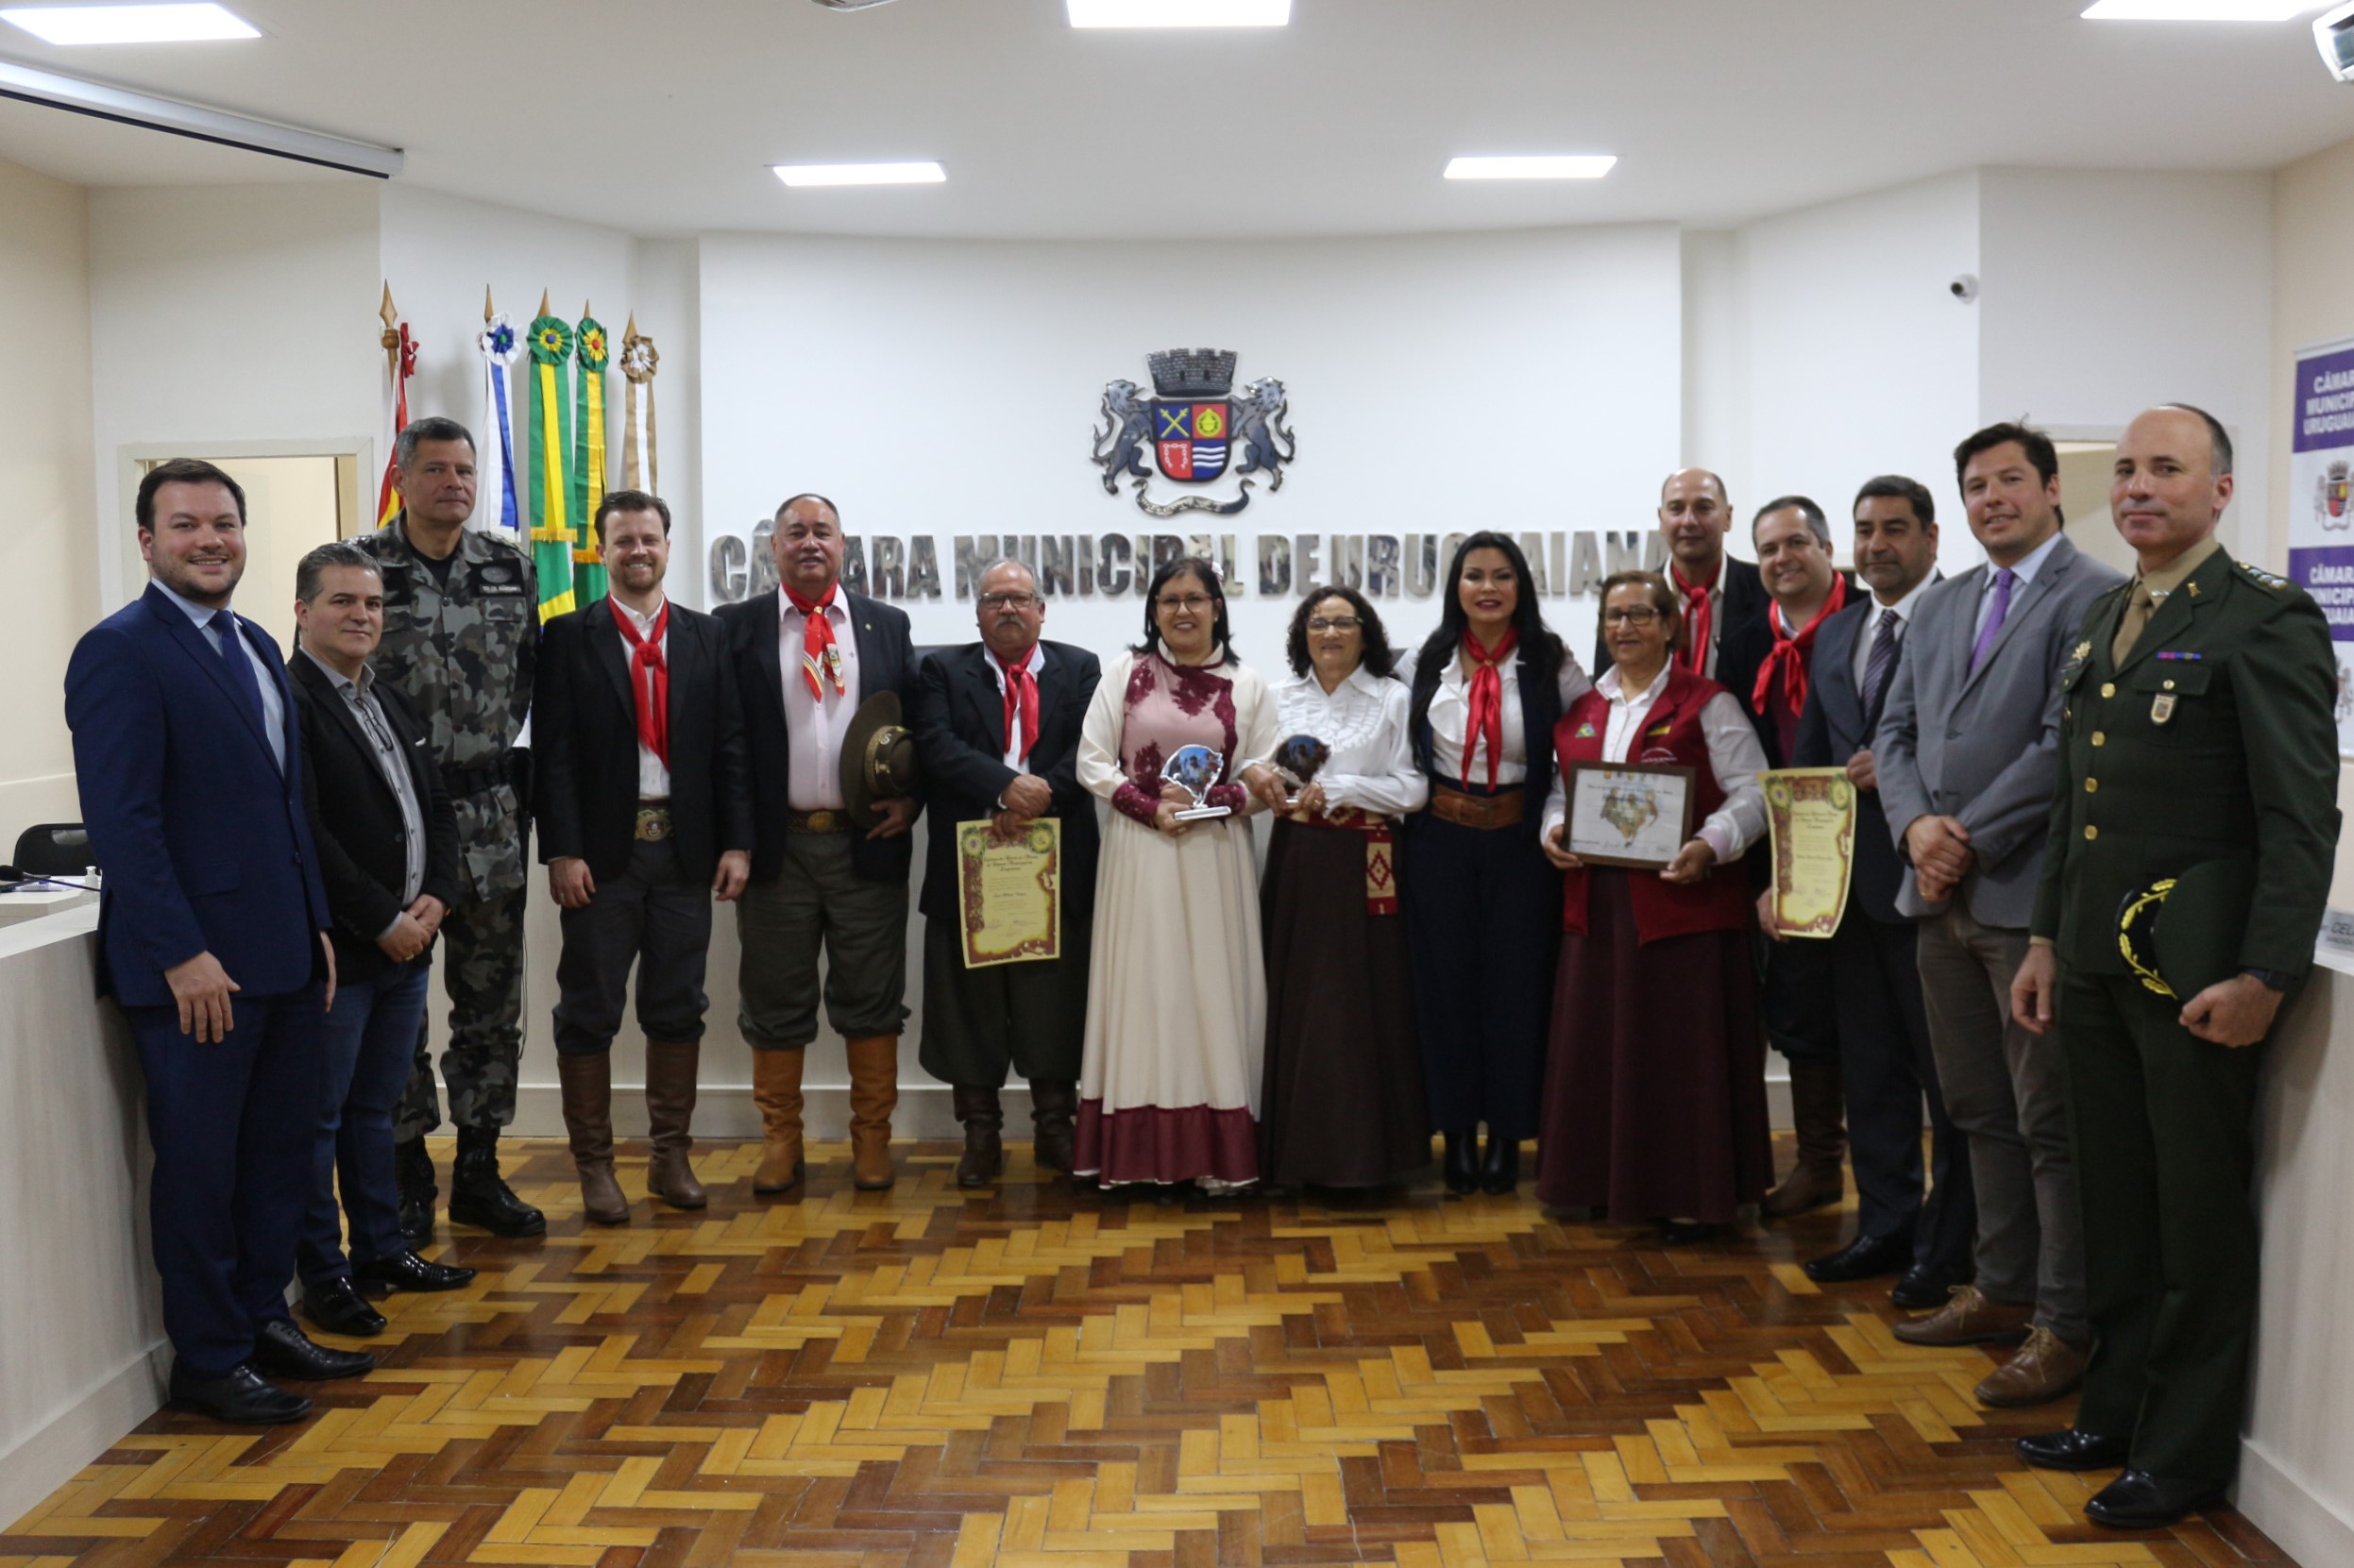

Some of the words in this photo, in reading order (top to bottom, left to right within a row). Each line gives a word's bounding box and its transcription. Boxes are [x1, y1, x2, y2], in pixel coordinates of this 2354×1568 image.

[711, 519, 941, 600] CÂARA
[1258, 534, 1321, 597] DE
[2310, 563, 2354, 584] CÂMAR
